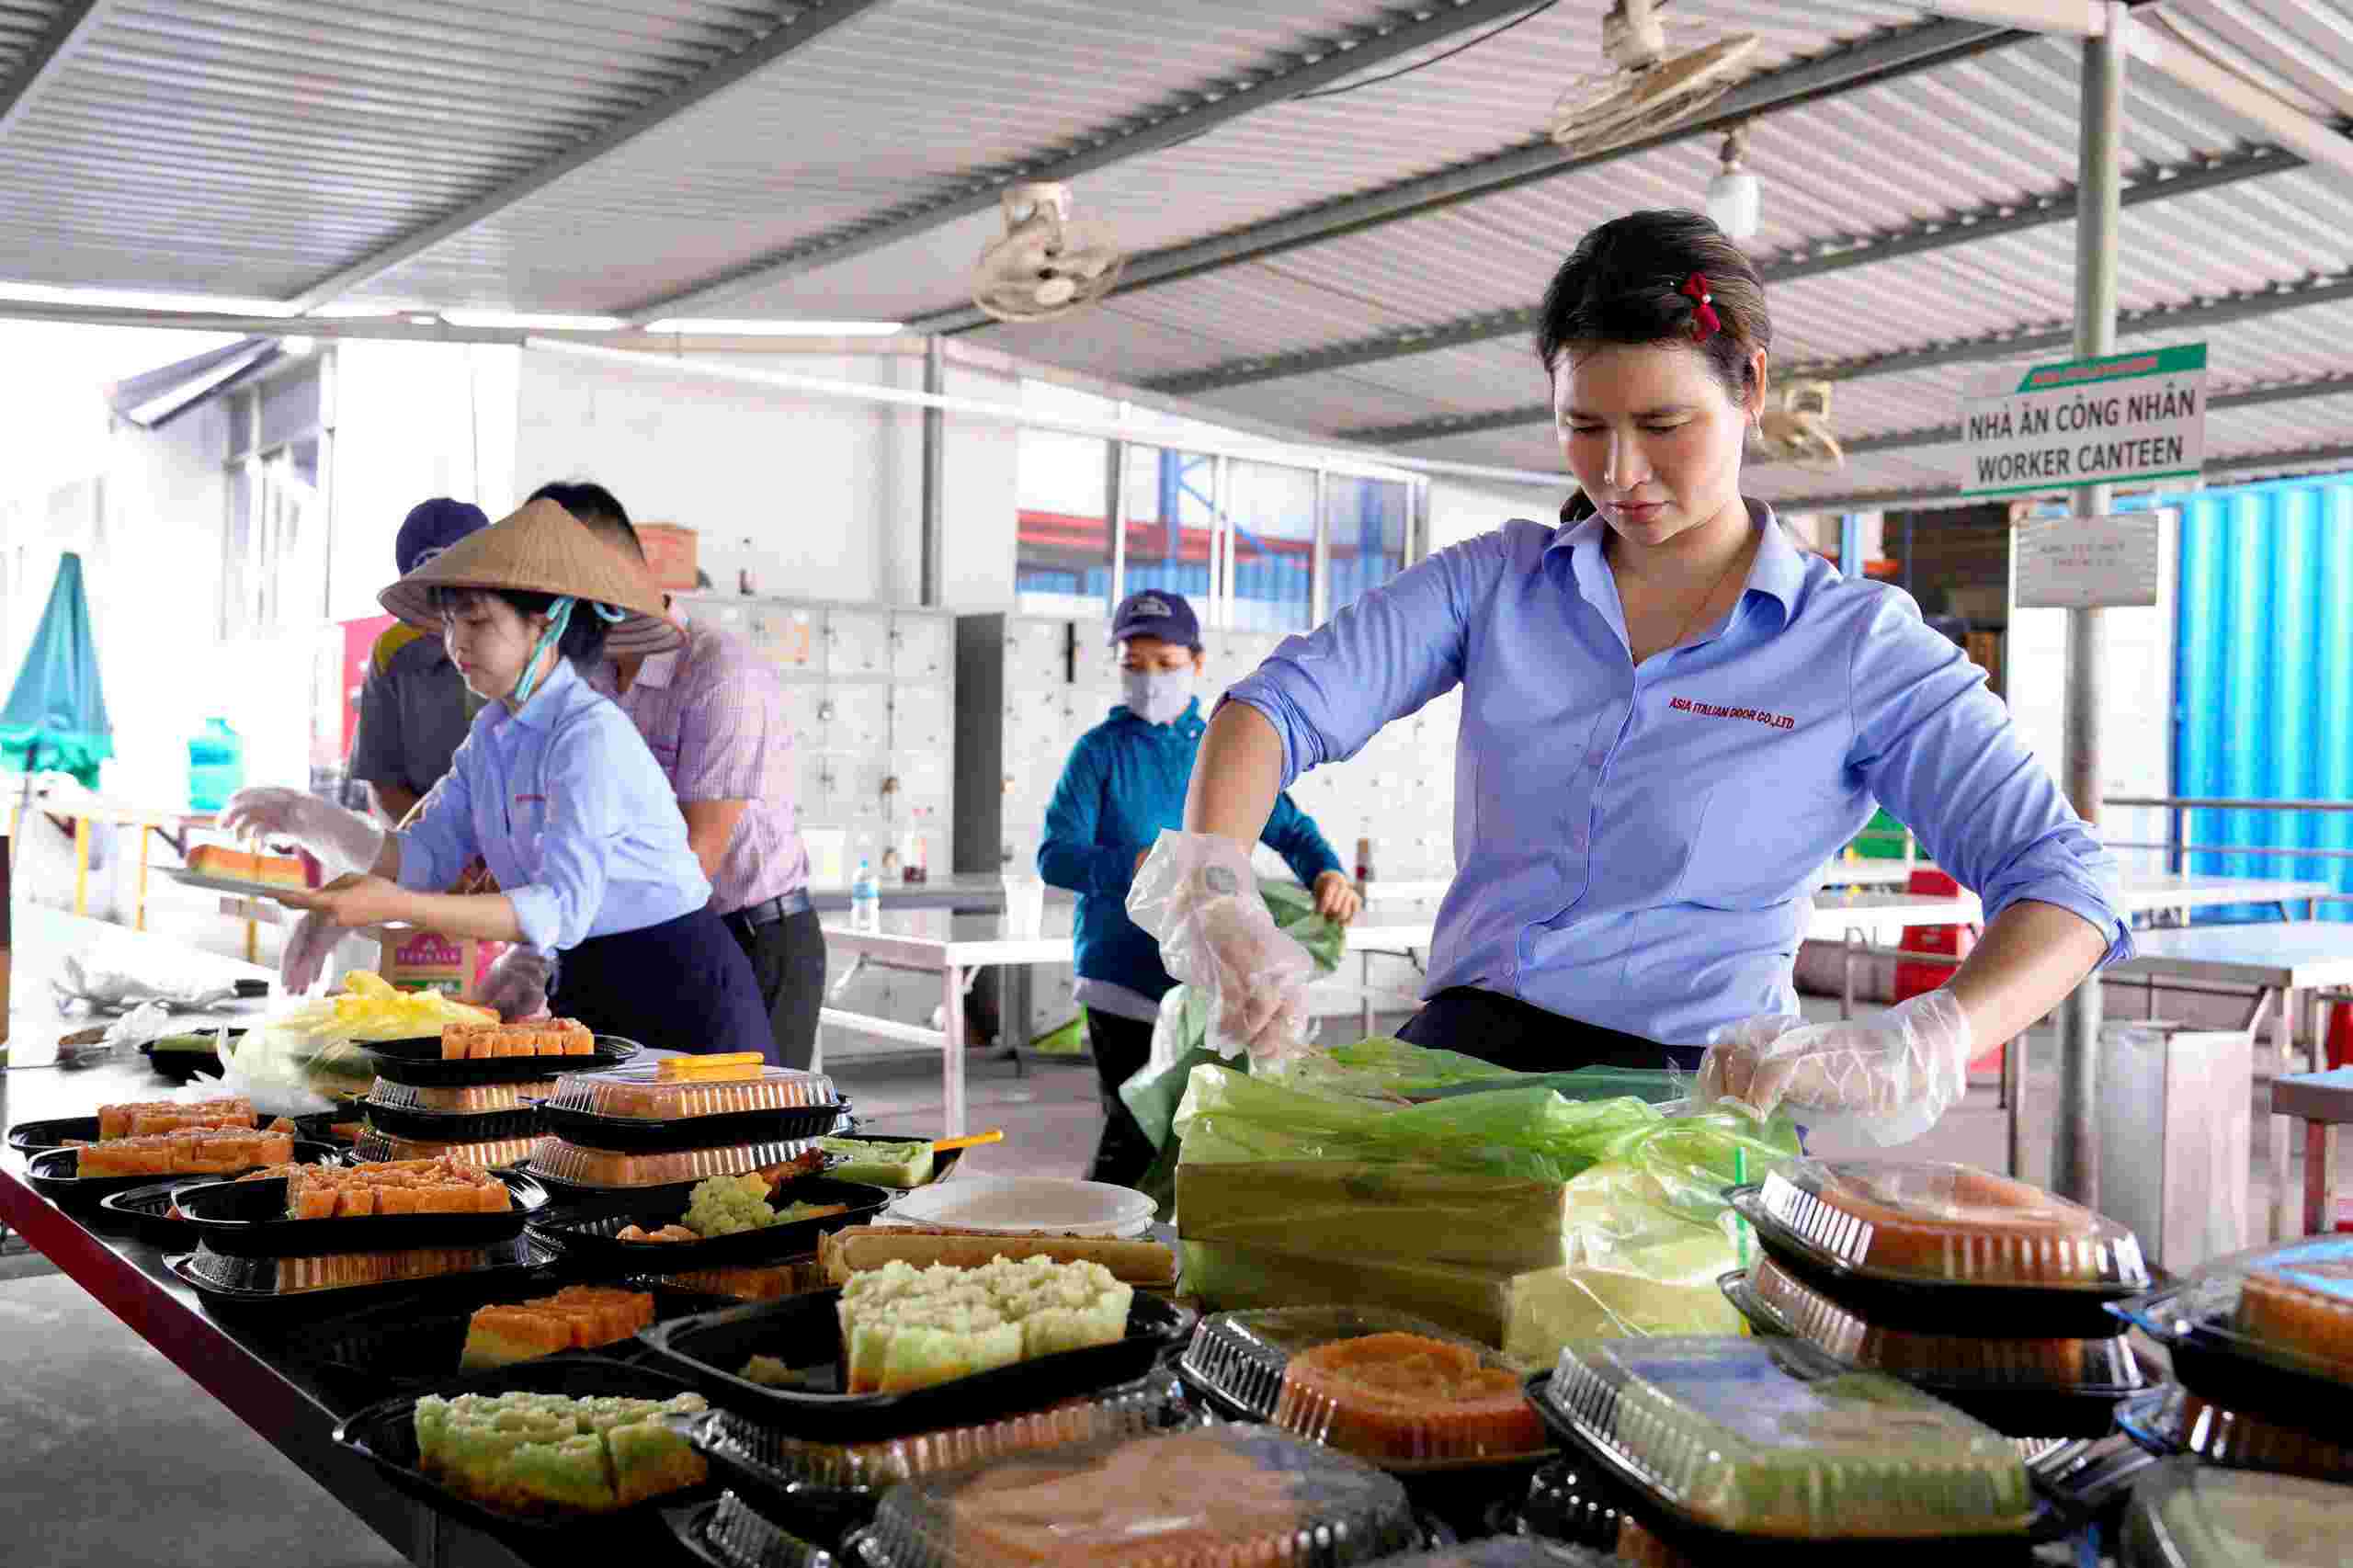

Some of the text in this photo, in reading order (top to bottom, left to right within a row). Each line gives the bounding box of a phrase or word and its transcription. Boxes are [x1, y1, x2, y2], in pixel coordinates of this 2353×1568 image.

[1970, 382, 2195, 440] NHÀ ĂN CÔNG NHÂN
[1978, 435, 2183, 483] WORKER CANTEEN
[1669, 697, 1692, 711] ASIA
[1692, 702, 1728, 717] ITALIAN
